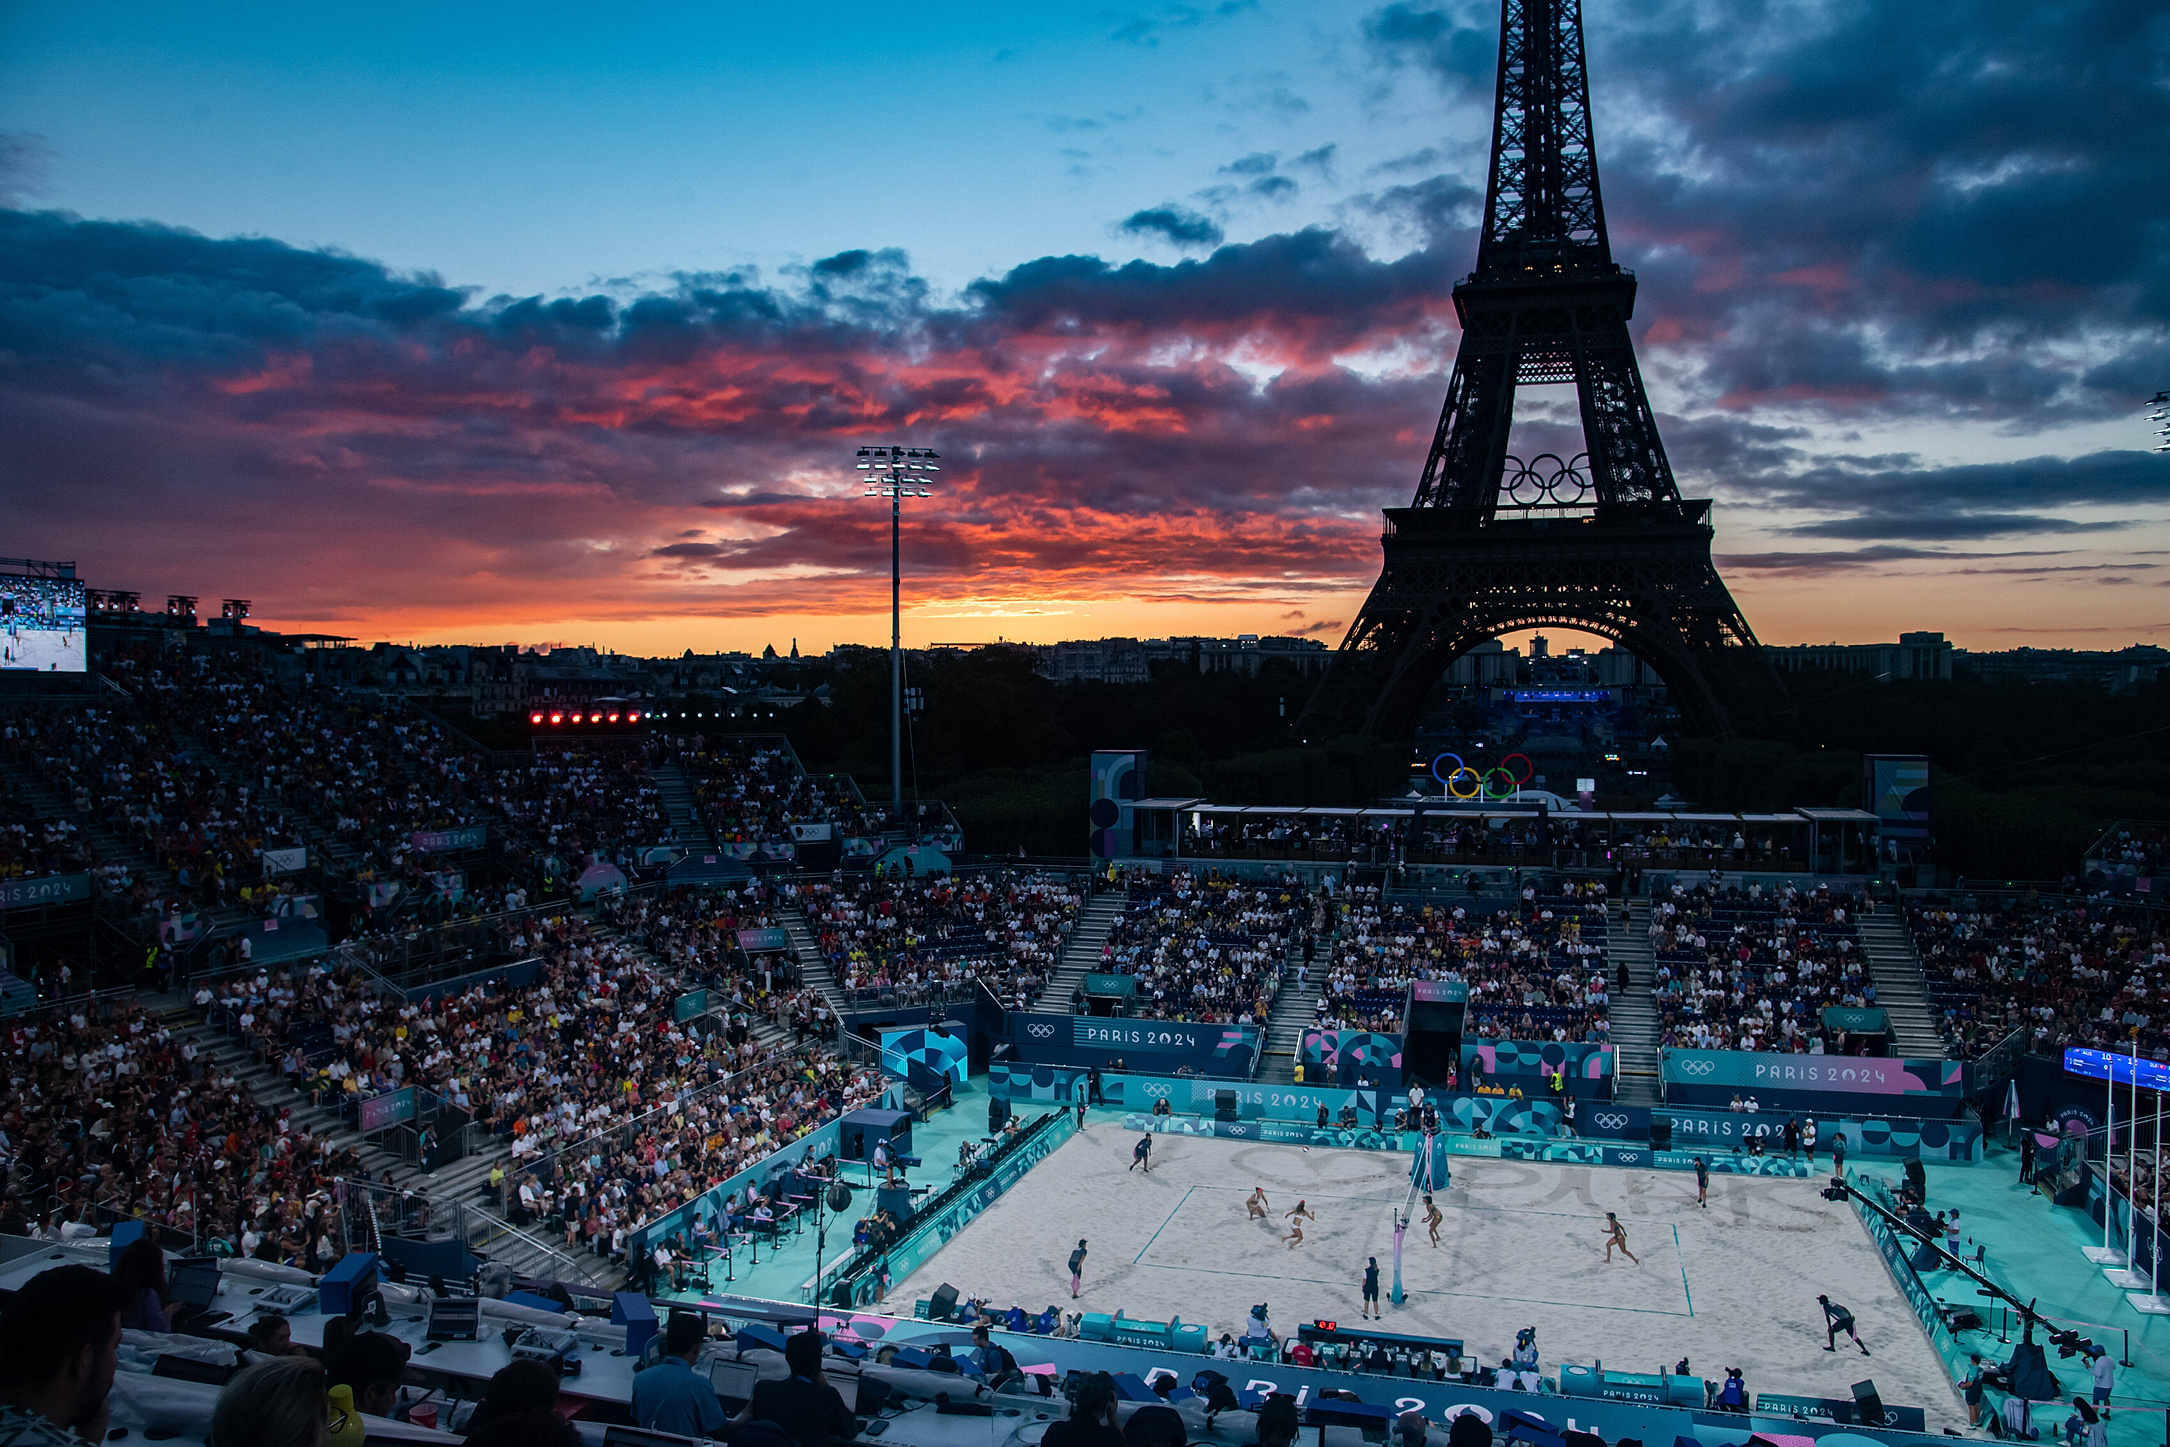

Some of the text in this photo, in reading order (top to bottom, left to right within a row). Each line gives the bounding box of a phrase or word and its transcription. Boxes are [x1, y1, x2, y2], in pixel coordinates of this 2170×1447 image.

[27, 882, 71, 899] 2024
[1147, 1031, 1195, 1047] 2024
[1828, 1067, 1885, 1083] 2024
[1271, 1093, 1322, 1109] 2024
[1742, 1122, 1786, 1138] 202
[1633, 1393, 1659, 1401] 2024
[1802, 1406, 1833, 1417] 2024
